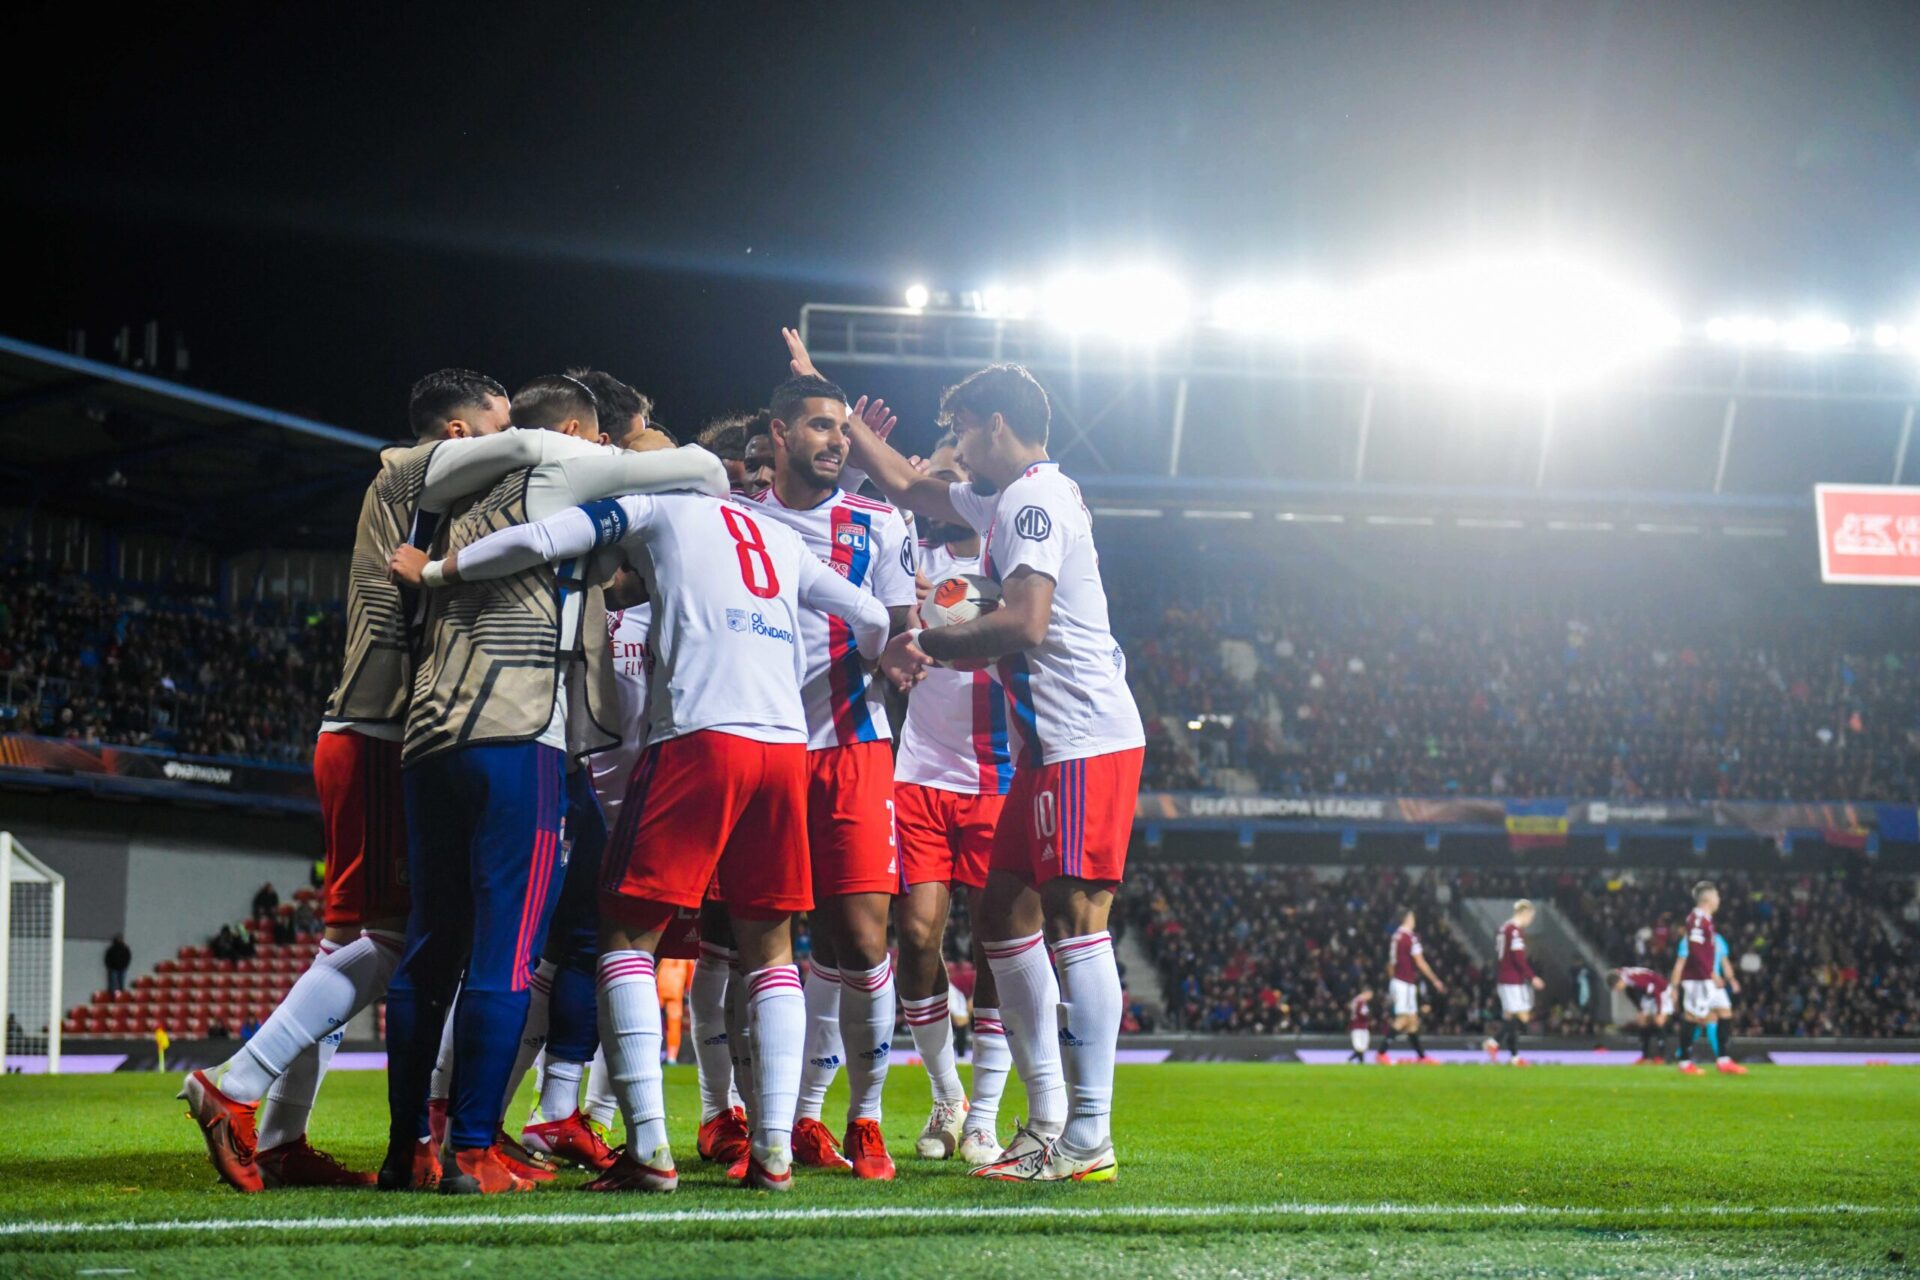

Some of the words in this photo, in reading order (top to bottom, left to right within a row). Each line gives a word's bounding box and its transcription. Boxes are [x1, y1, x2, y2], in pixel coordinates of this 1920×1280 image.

[720, 505, 780, 599] 8
[751, 613, 765, 626] OL
[886, 800, 895, 846] 3
[1034, 791, 1056, 840] 10
